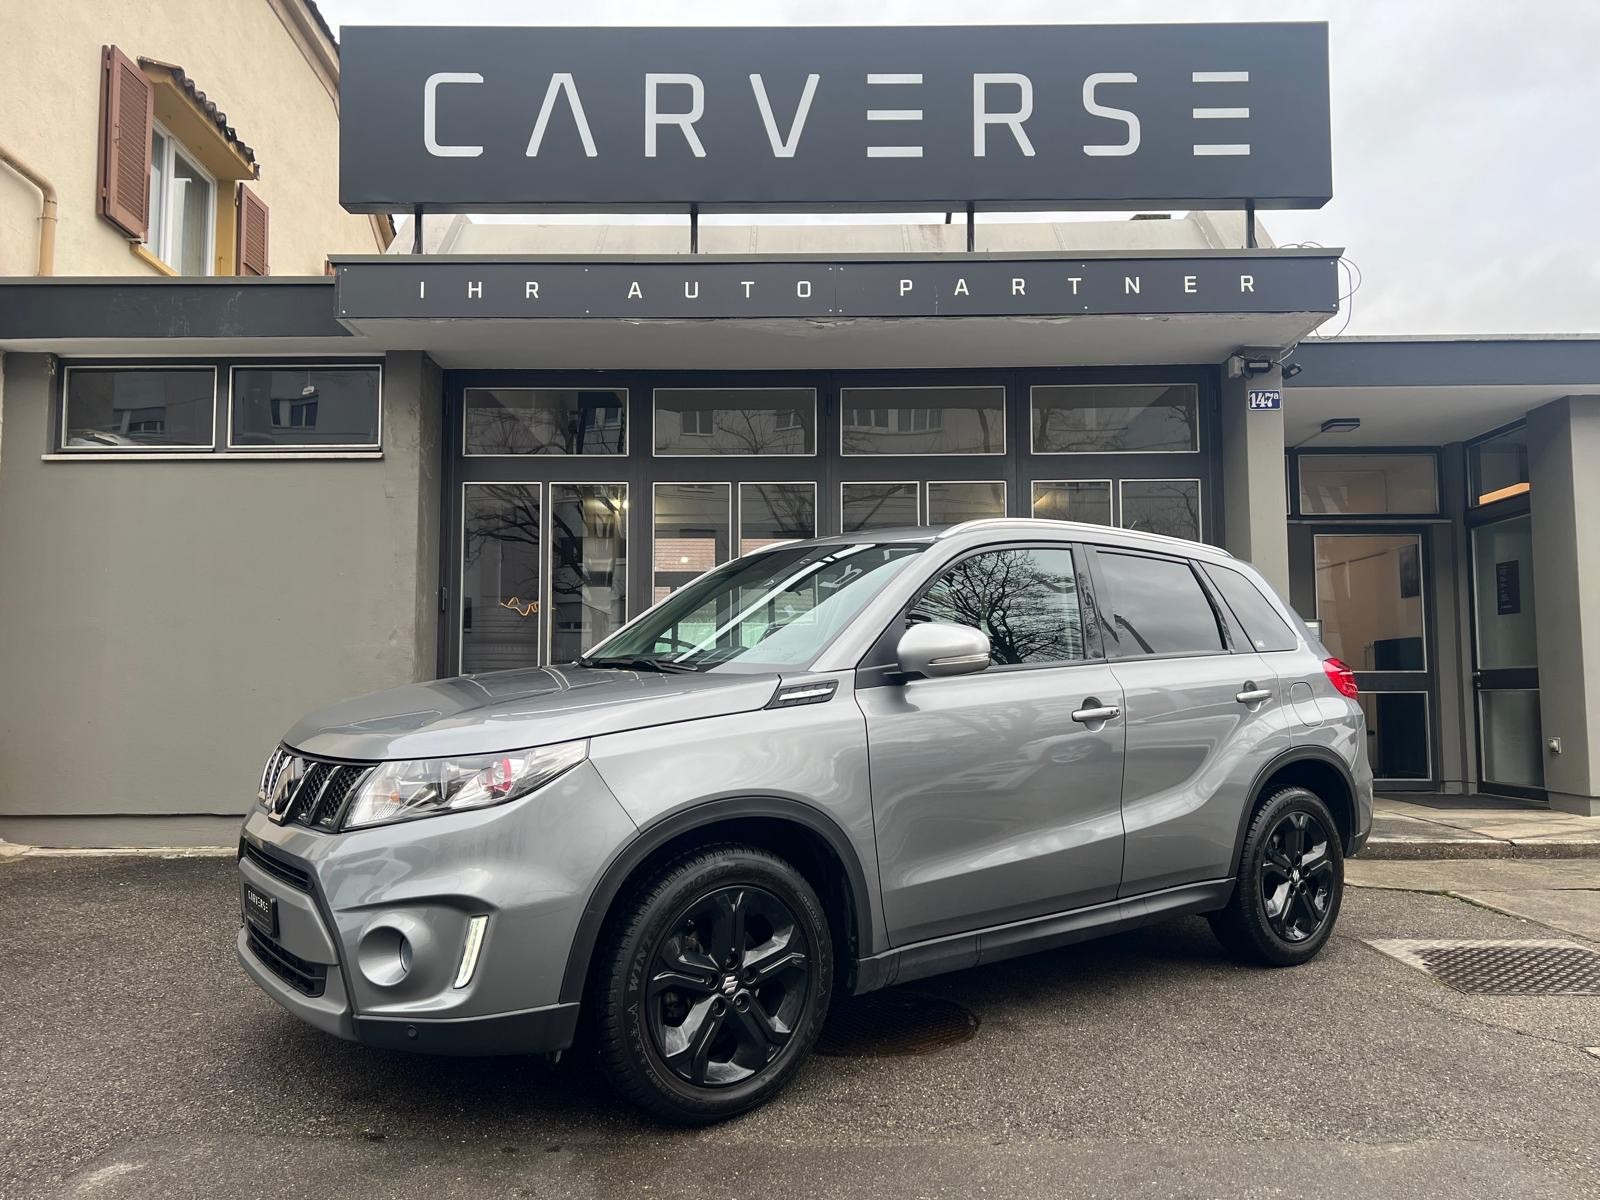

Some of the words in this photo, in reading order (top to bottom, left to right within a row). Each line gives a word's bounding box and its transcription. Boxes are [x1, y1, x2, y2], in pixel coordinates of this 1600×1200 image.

[423, 71, 1251, 158] CARVERSE
[420, 281, 539, 299] IHR
[627, 281, 812, 299] AUTO
[899, 274, 1255, 297] PARTNER
